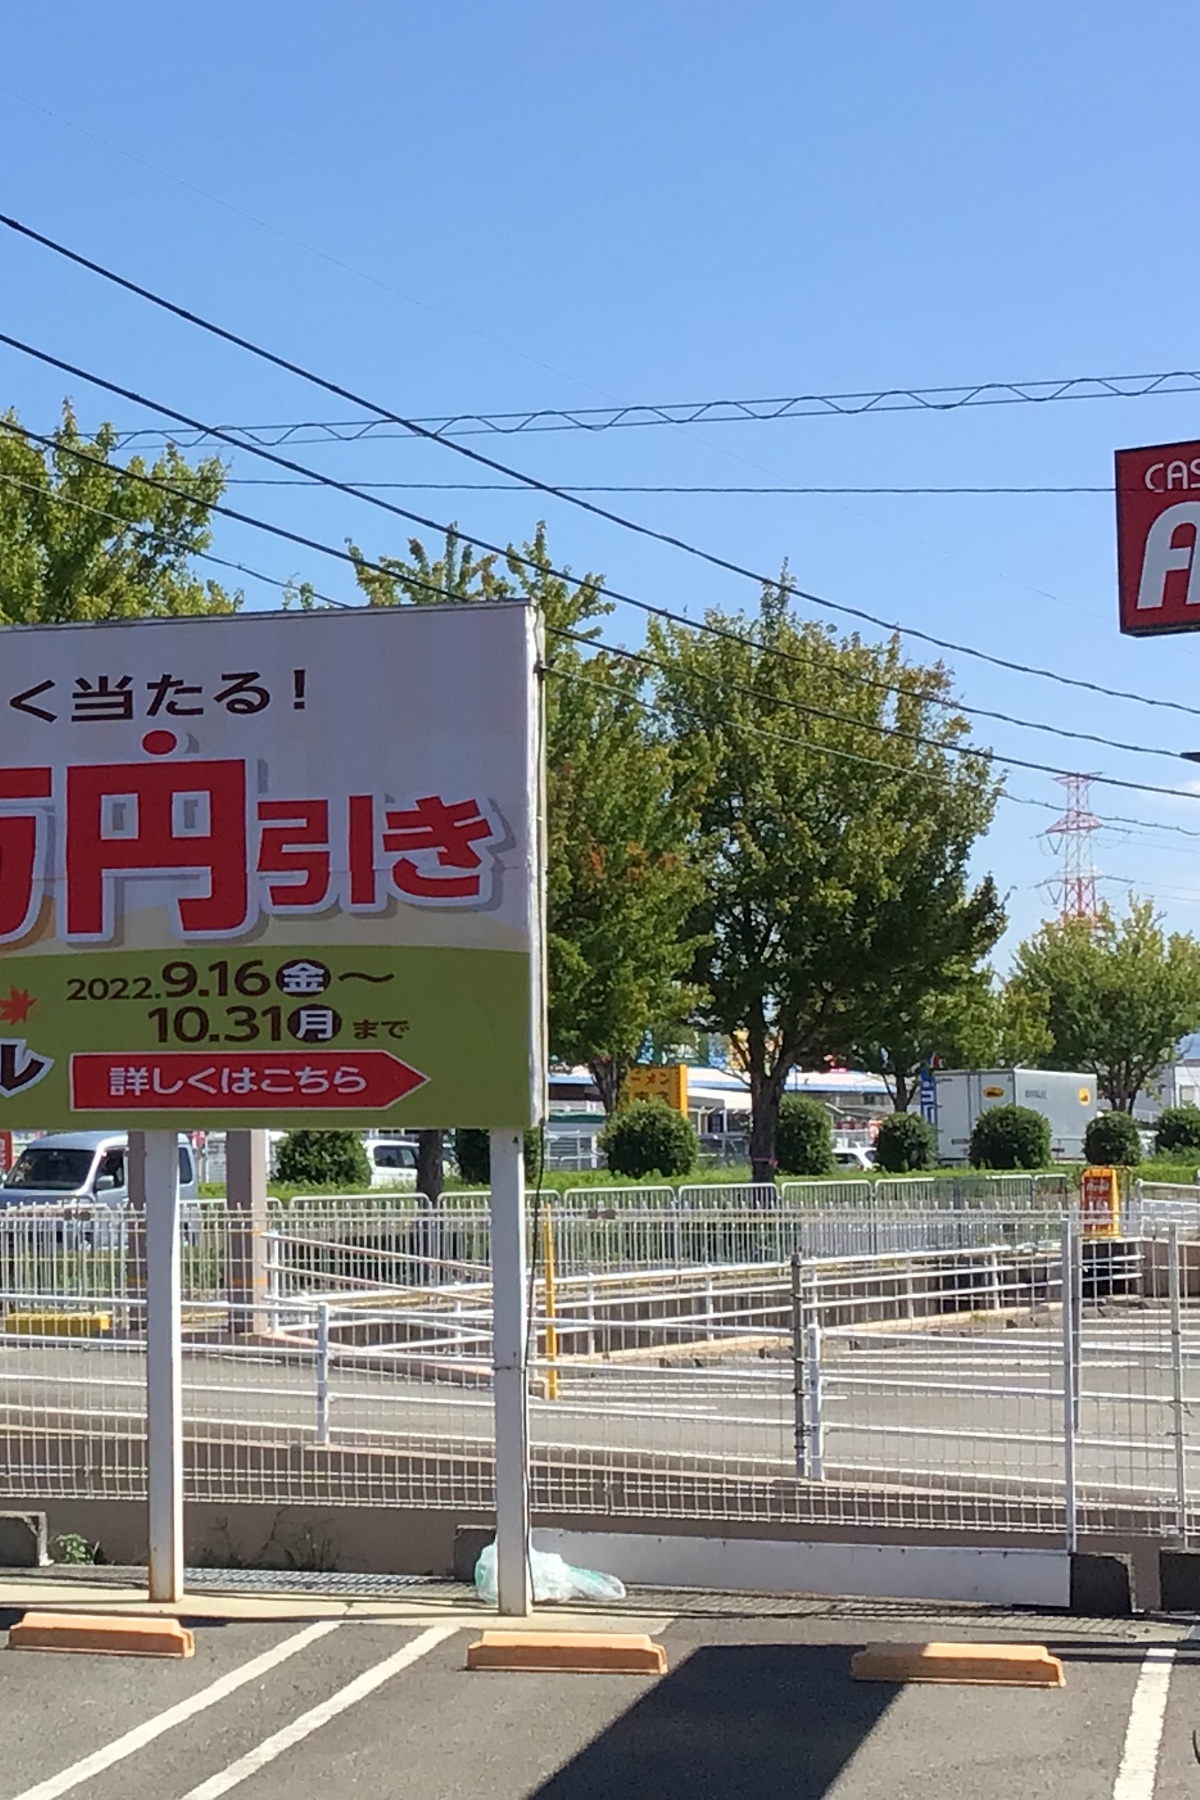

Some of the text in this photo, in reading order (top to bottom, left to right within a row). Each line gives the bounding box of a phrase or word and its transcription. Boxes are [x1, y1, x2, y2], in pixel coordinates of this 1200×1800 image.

[109, 1066, 367, 1096] 詳しくはこちら
